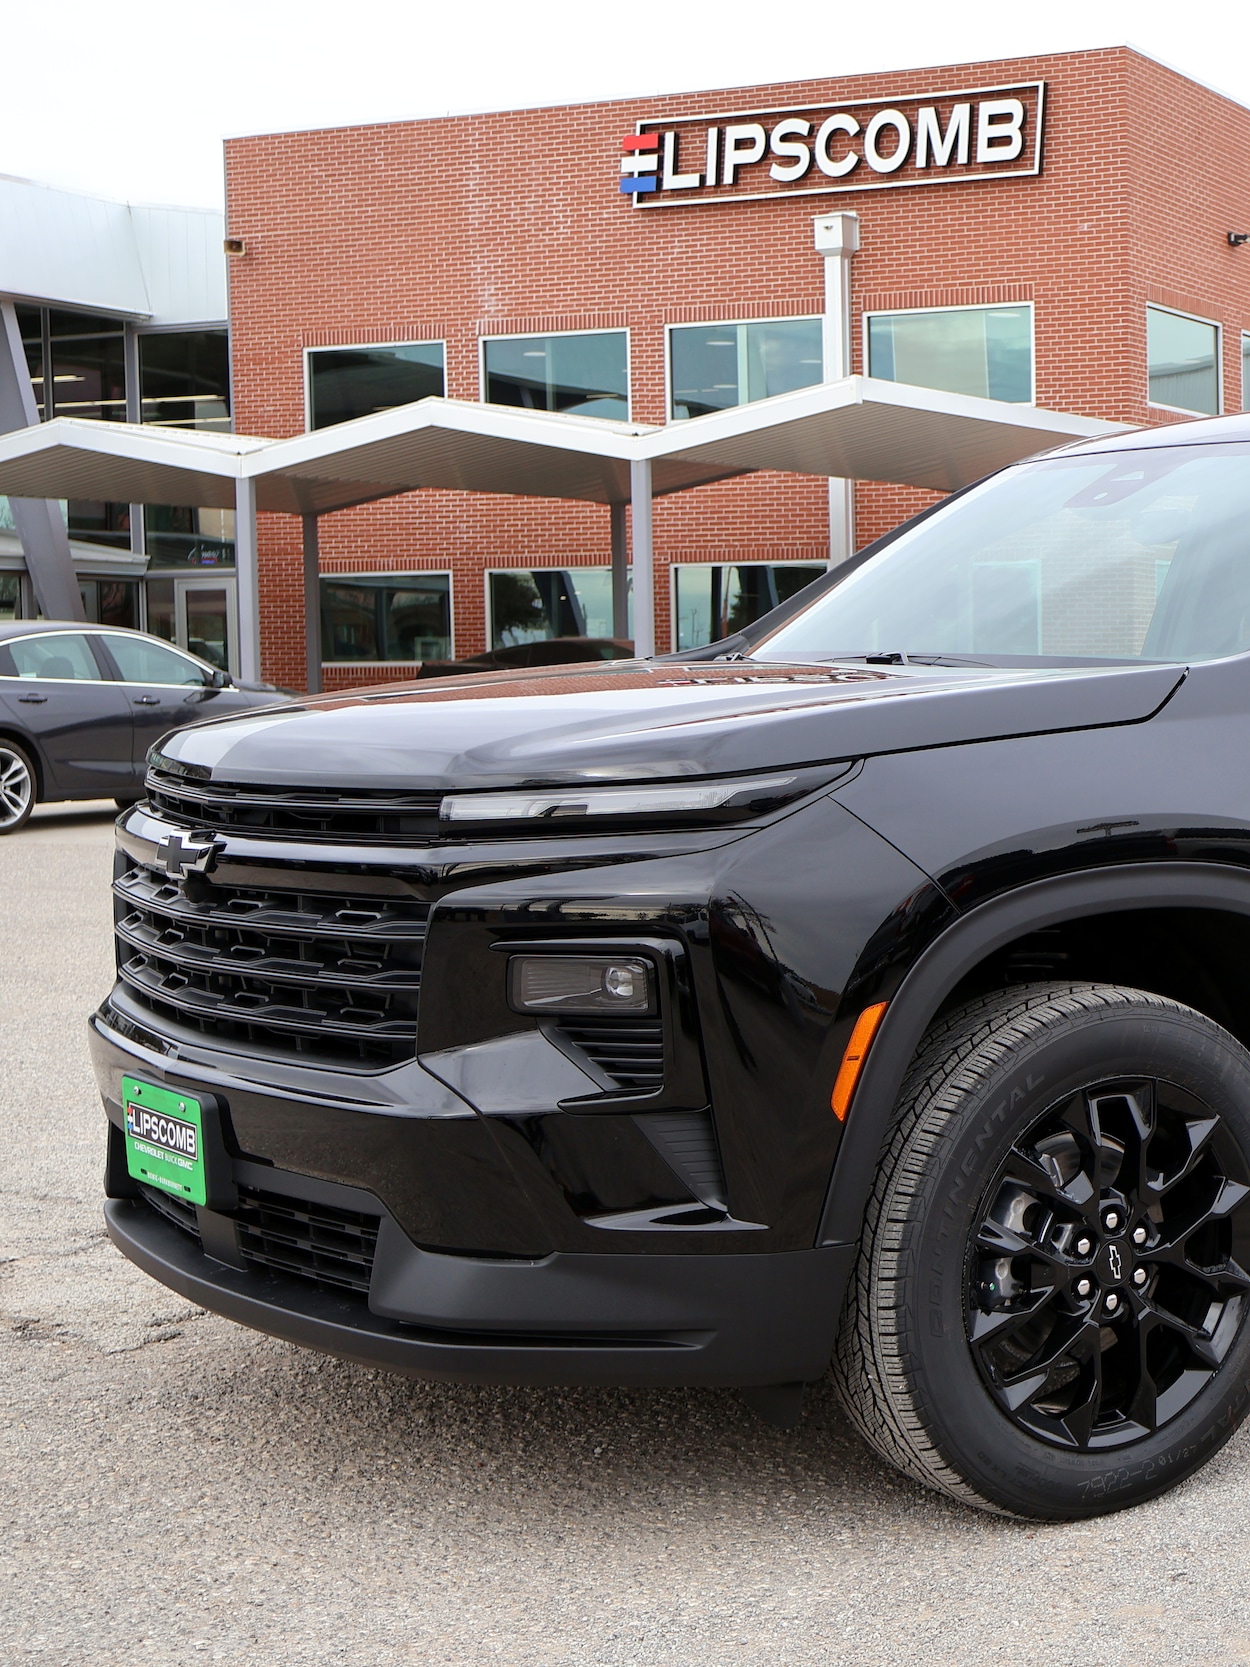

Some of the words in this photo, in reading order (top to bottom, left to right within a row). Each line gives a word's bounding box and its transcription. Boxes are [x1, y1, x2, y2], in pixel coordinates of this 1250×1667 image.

[662, 97, 1026, 191] LIPSCOMB
[132, 1108, 196, 1154] LIPSCOMB
[134, 1141, 165, 1160] CHEVROLET
[178, 1159, 194, 1171] GMC
[929, 1072, 1046, 1338] CONTINENTAL
